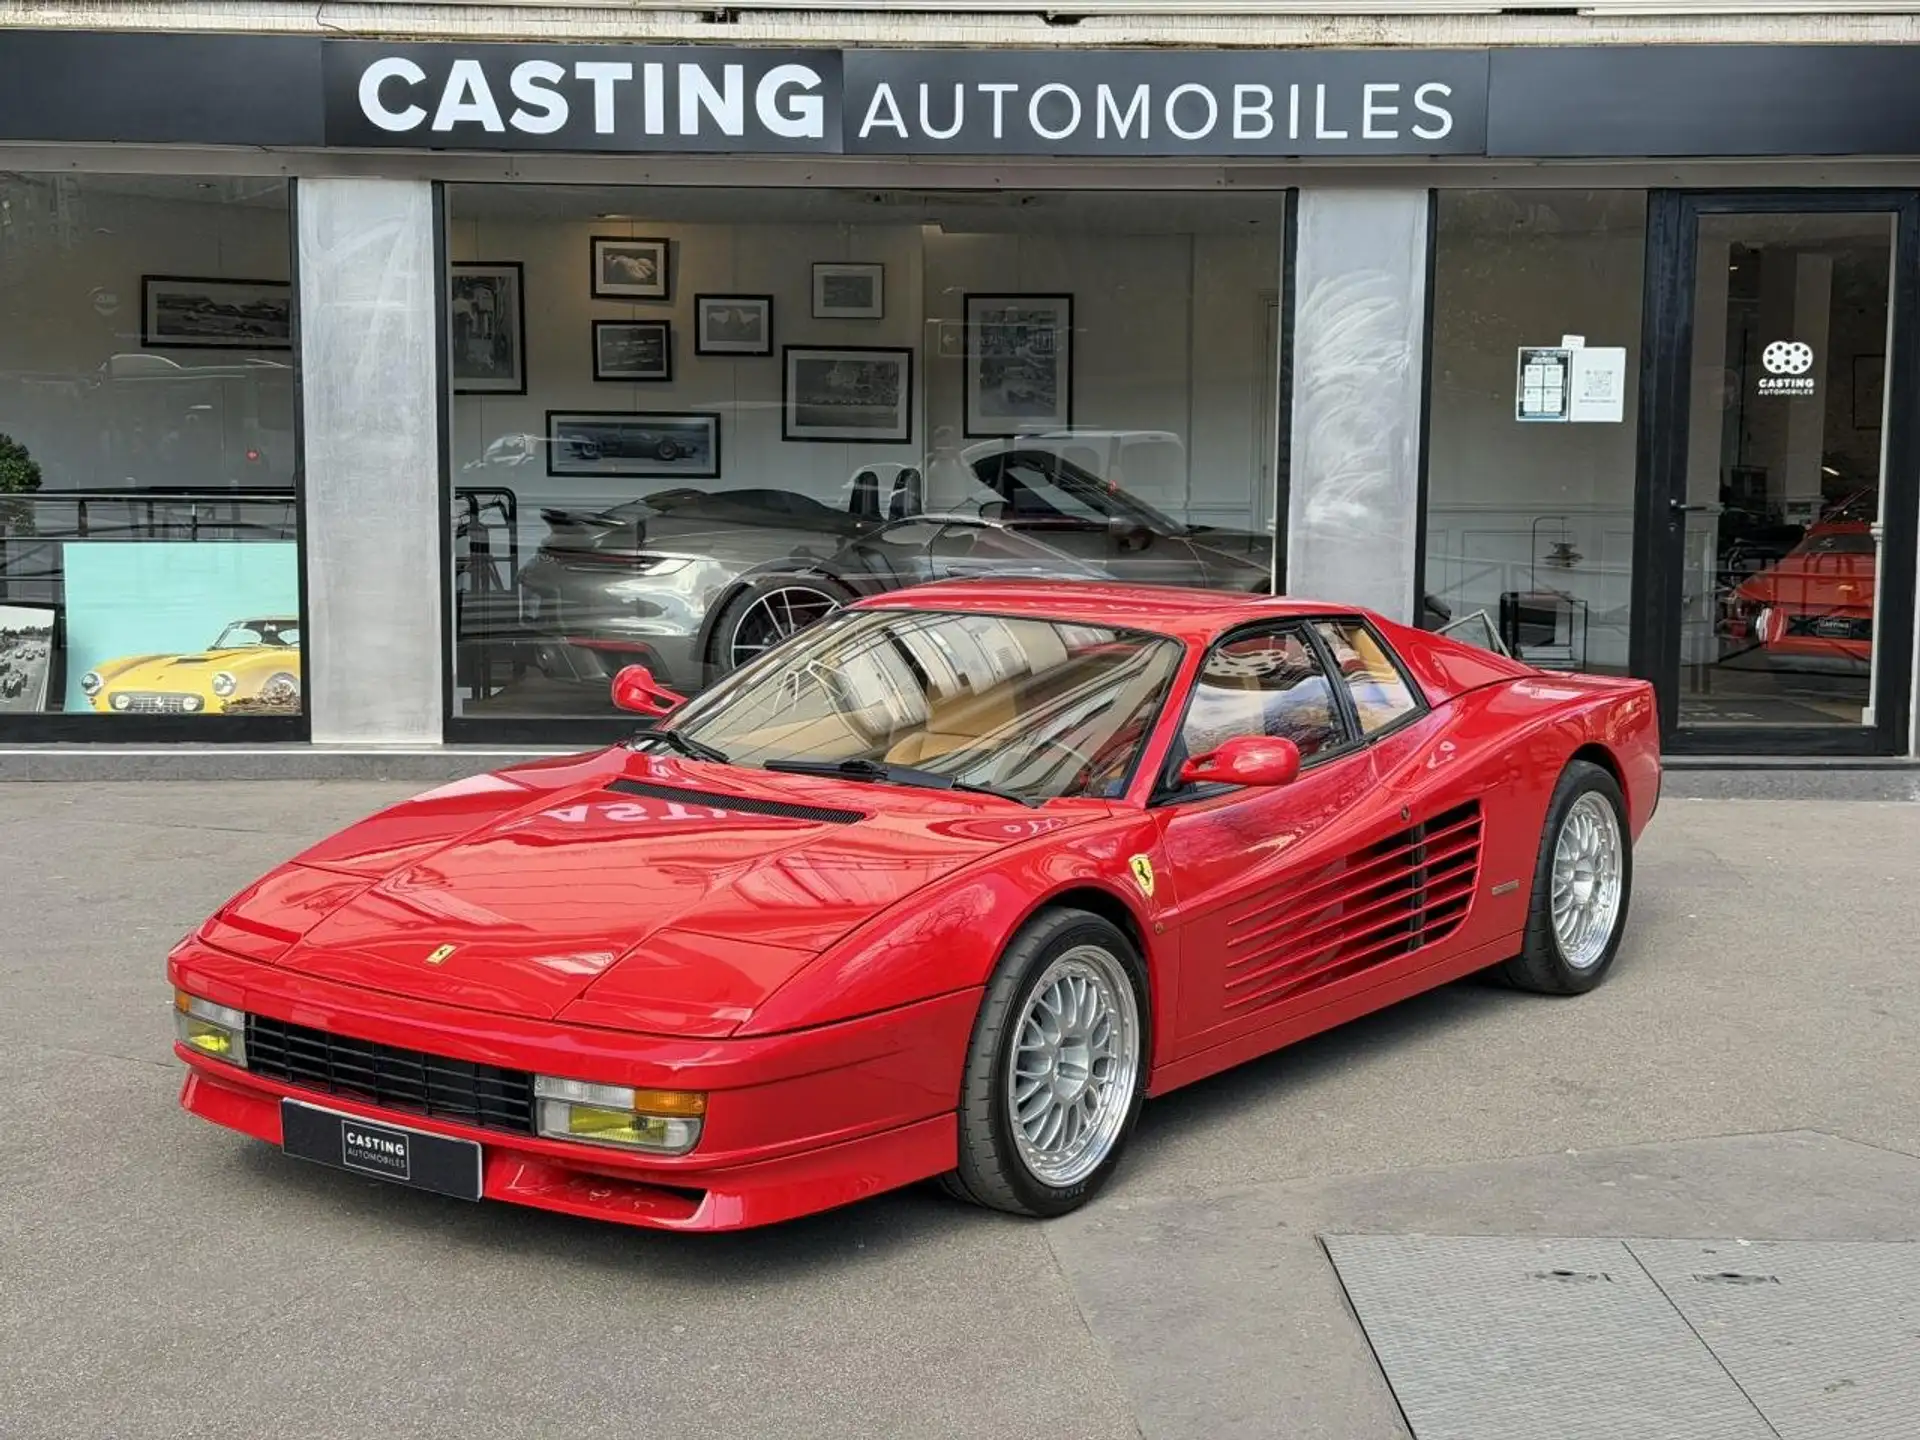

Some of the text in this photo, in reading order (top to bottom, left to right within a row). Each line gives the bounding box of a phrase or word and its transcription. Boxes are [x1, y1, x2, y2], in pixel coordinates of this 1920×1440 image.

[358, 57, 1453, 140] CASTING AUTOMOBILES
[1758, 378, 1814, 388] CASTING
[347, 1132, 404, 1156] CASTING
[347, 1147, 405, 1168] AUTOMOBILES
